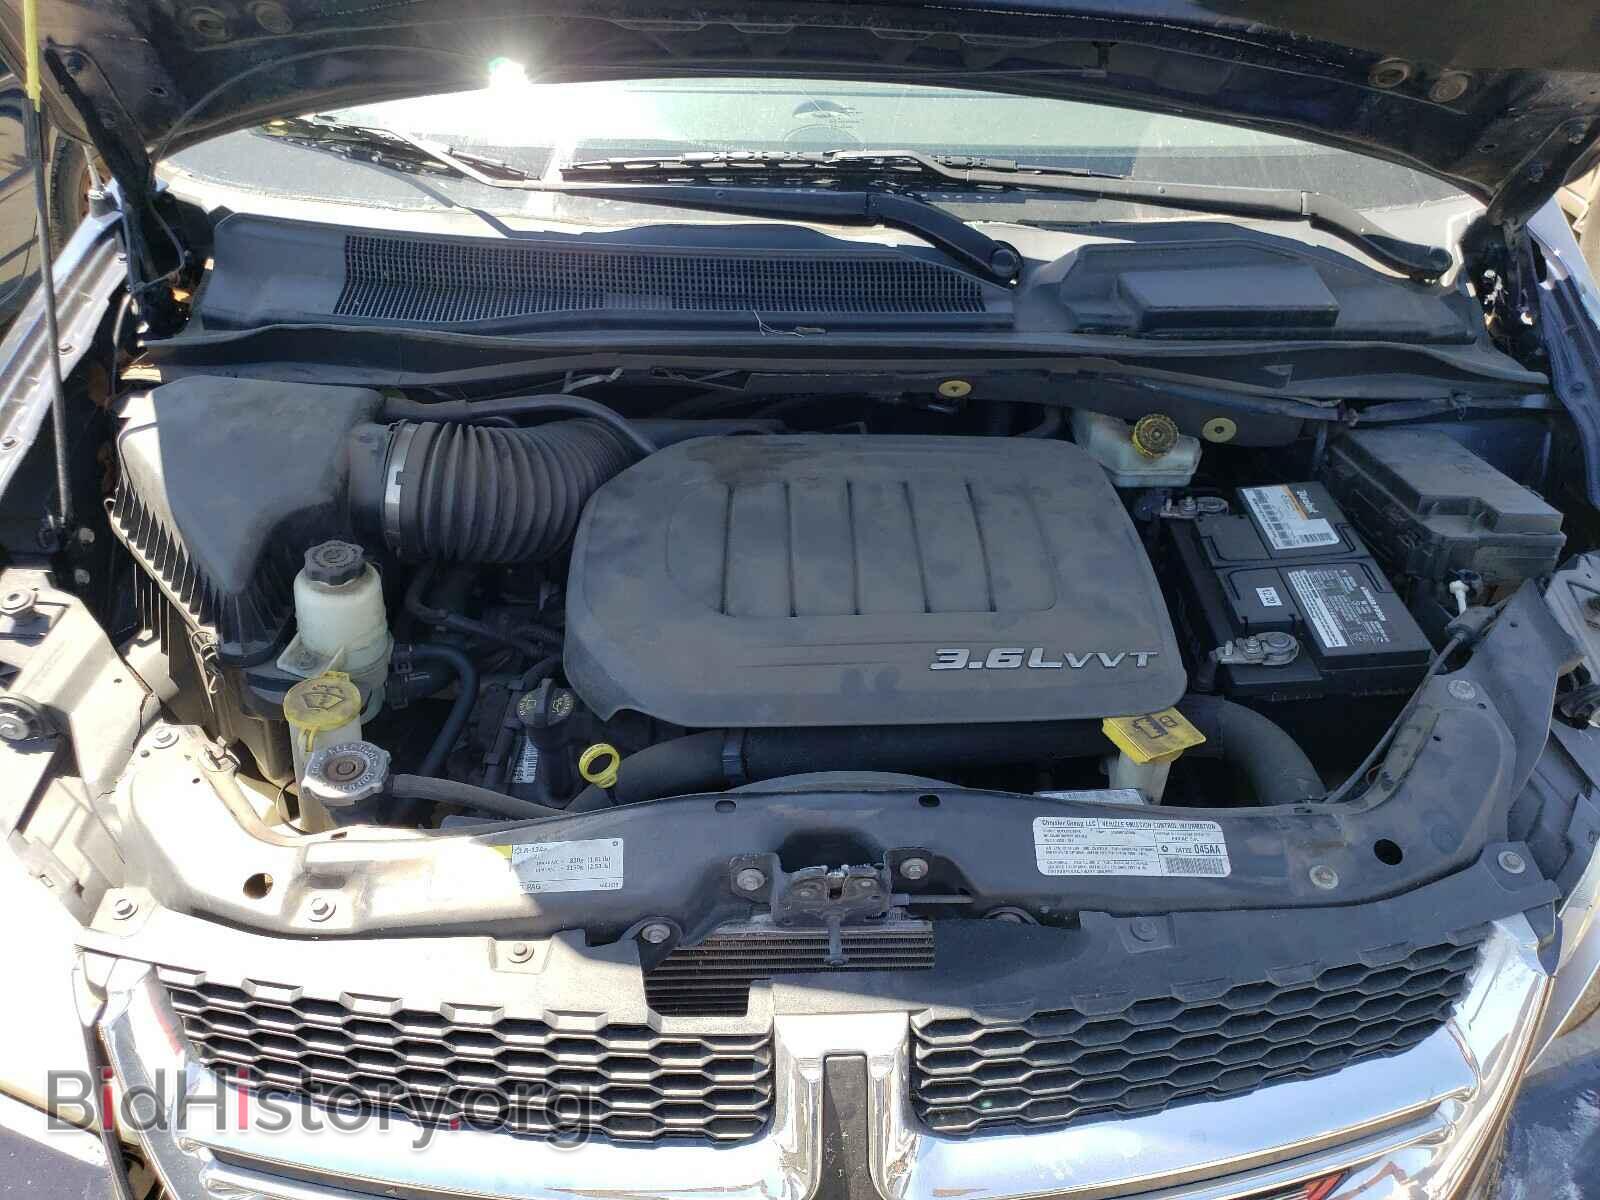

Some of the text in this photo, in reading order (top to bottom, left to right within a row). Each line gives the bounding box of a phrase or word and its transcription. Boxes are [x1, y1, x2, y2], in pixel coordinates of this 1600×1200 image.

[1066, 819, 1085, 827] Group
[1102, 820, 1123, 828] VEHICLE
[1124, 821, 1152, 829] EMISSION
[1178, 822, 1216, 830] INFORMATION
[1193, 844, 1221, 854] 045AA
